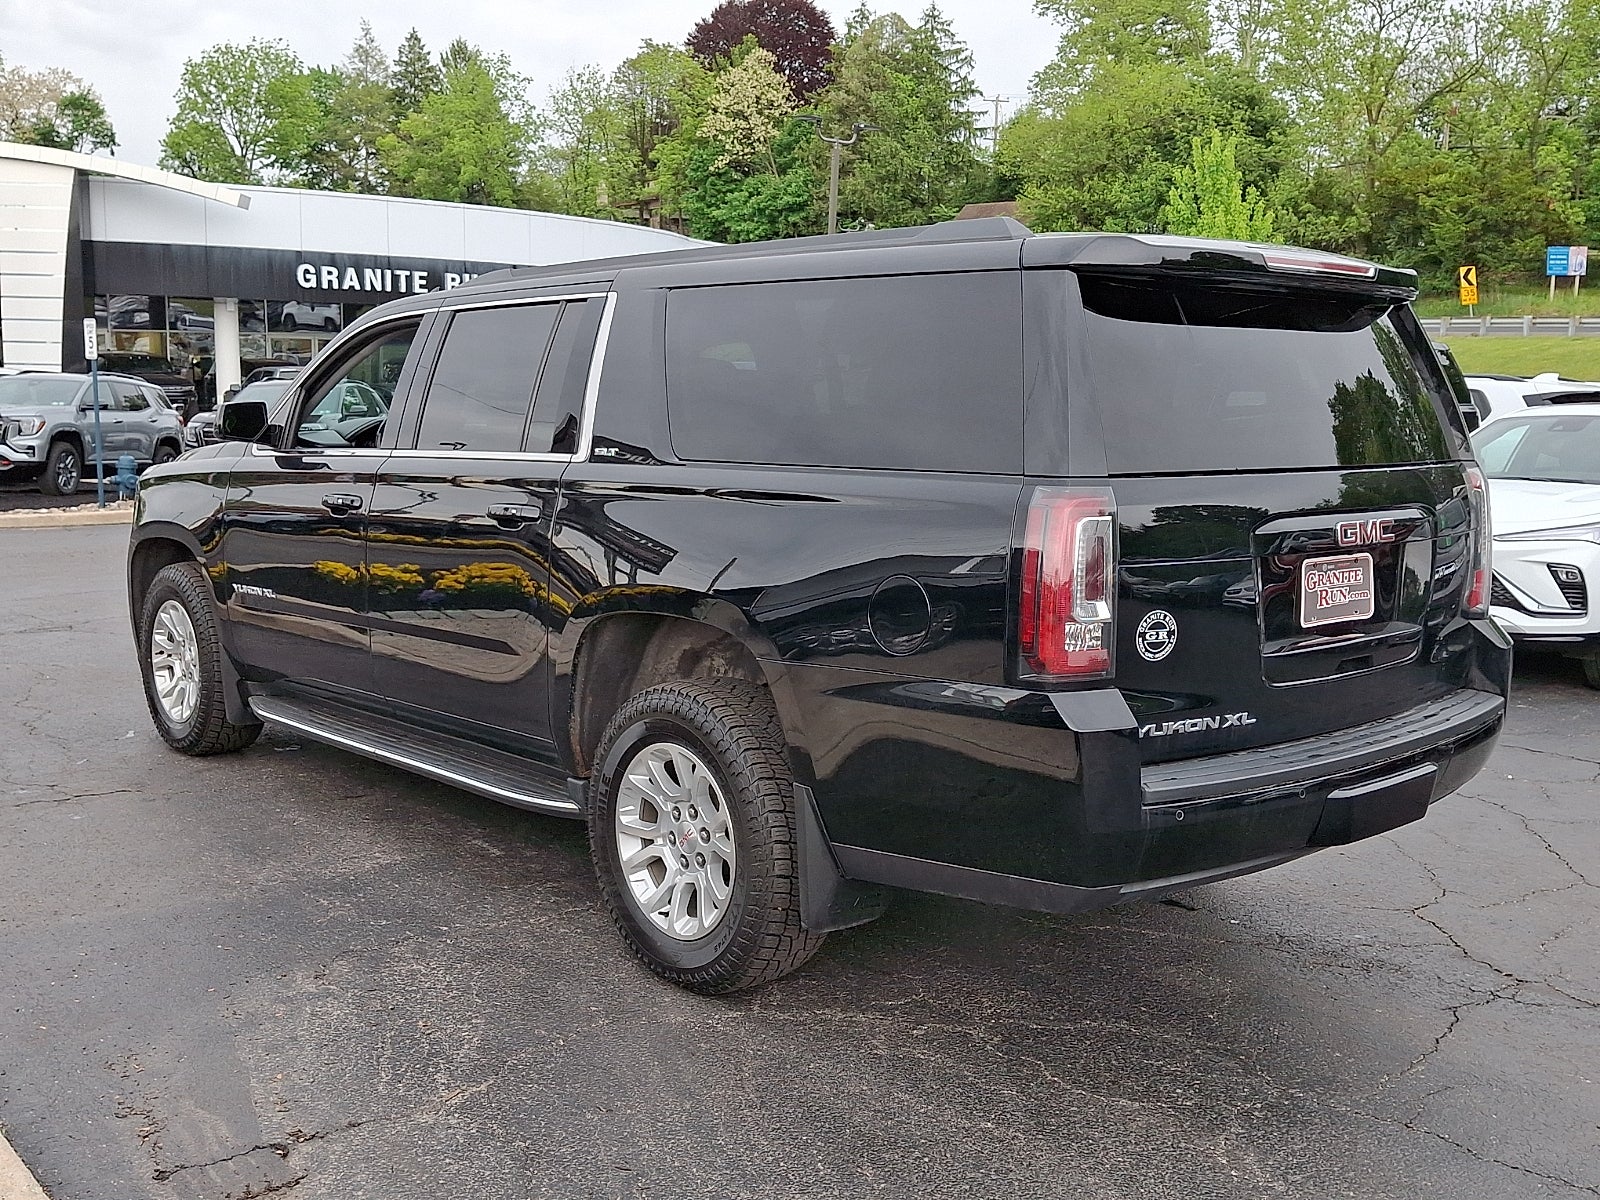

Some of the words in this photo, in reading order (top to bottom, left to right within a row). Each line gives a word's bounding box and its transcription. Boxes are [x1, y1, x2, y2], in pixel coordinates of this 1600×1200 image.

[296, 263, 429, 294] GRANITE
[1463, 288, 1476, 298] 35
[88, 335, 94, 350] 5
[594, 447, 620, 457] SLT
[1337, 518, 1395, 547] GMC
[231, 583, 262, 597] YUKON
[1306, 568, 1364, 592] GRANITE
[1139, 612, 1165, 633] GRANITE
[1145, 631, 1169, 641] GR
[1139, 716, 1220, 739] YUKON
[1222, 712, 1257, 729] XL
[679, 828, 694, 848] GMC
